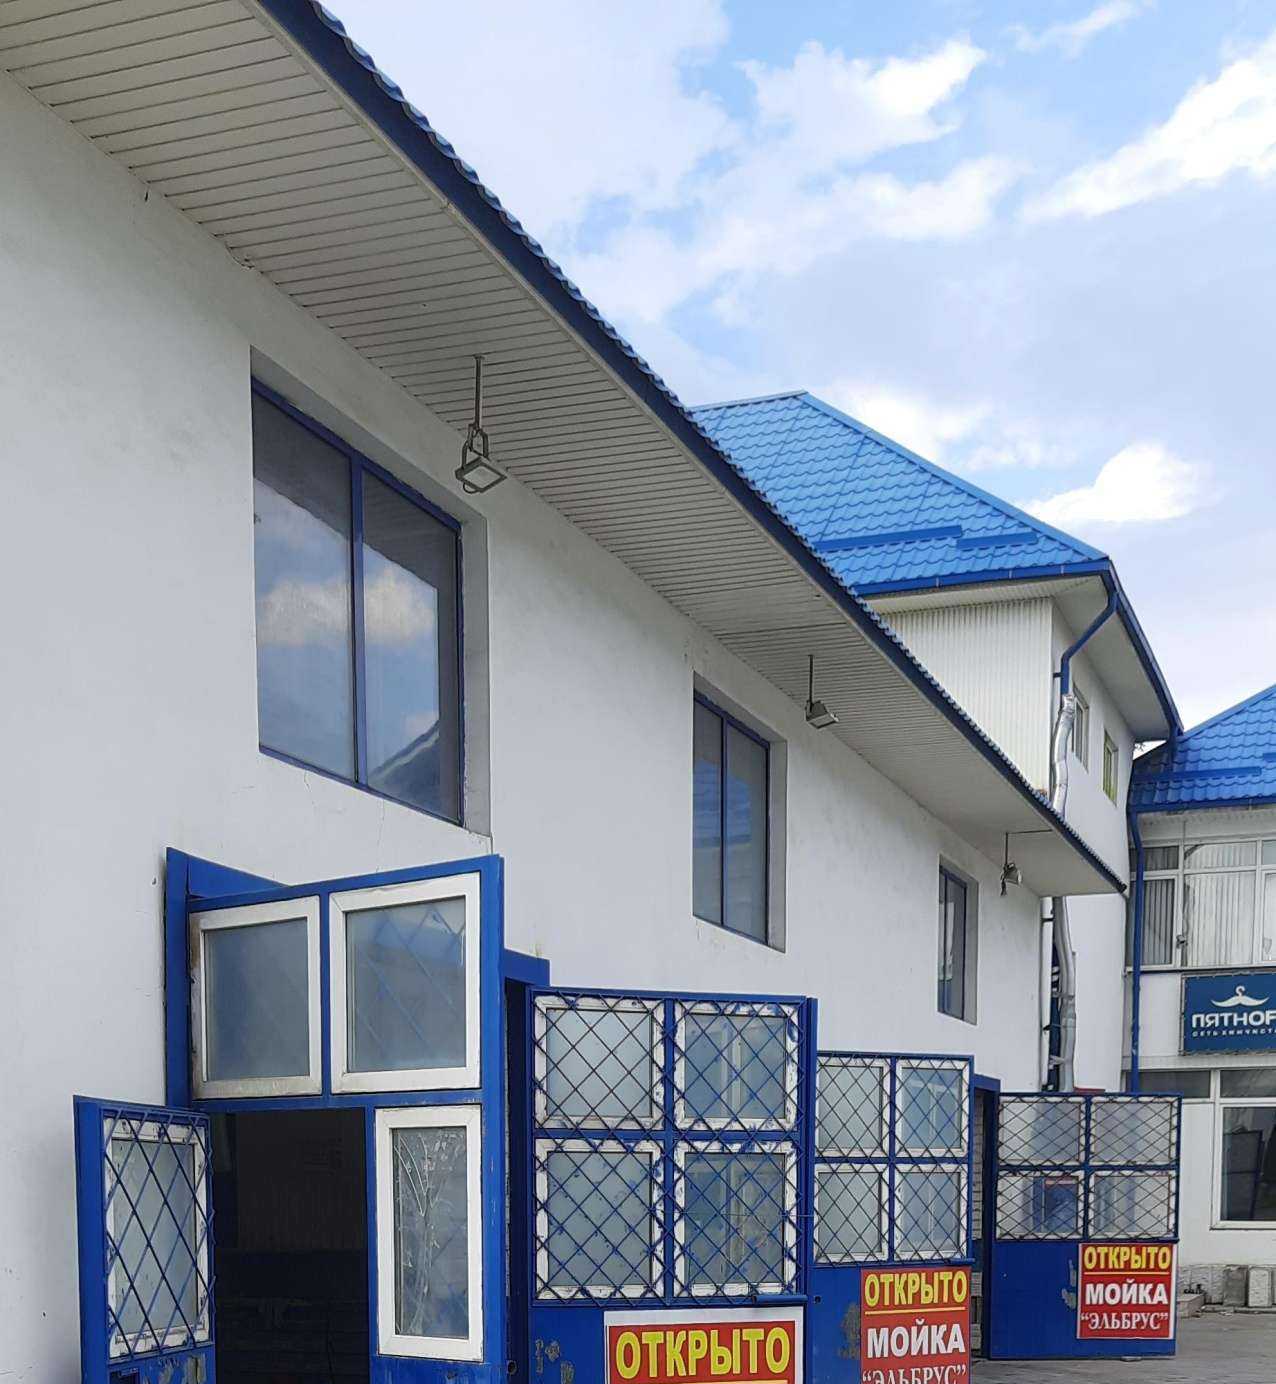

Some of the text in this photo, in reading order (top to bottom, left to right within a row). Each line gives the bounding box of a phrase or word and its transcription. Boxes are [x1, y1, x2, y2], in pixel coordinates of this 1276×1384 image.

[1222, 1028, 1276, 1036] ХИМЧИСТ
[1084, 1246, 1171, 1270] ОТКРЫТО
[864, 1270, 967, 1307] ОТКРЫТО
[1085, 1278, 1169, 1305] МОЙКА
[615, 1327, 790, 1379] ОТКРЫТО
[867, 1318, 966, 1358] МОЙКА
